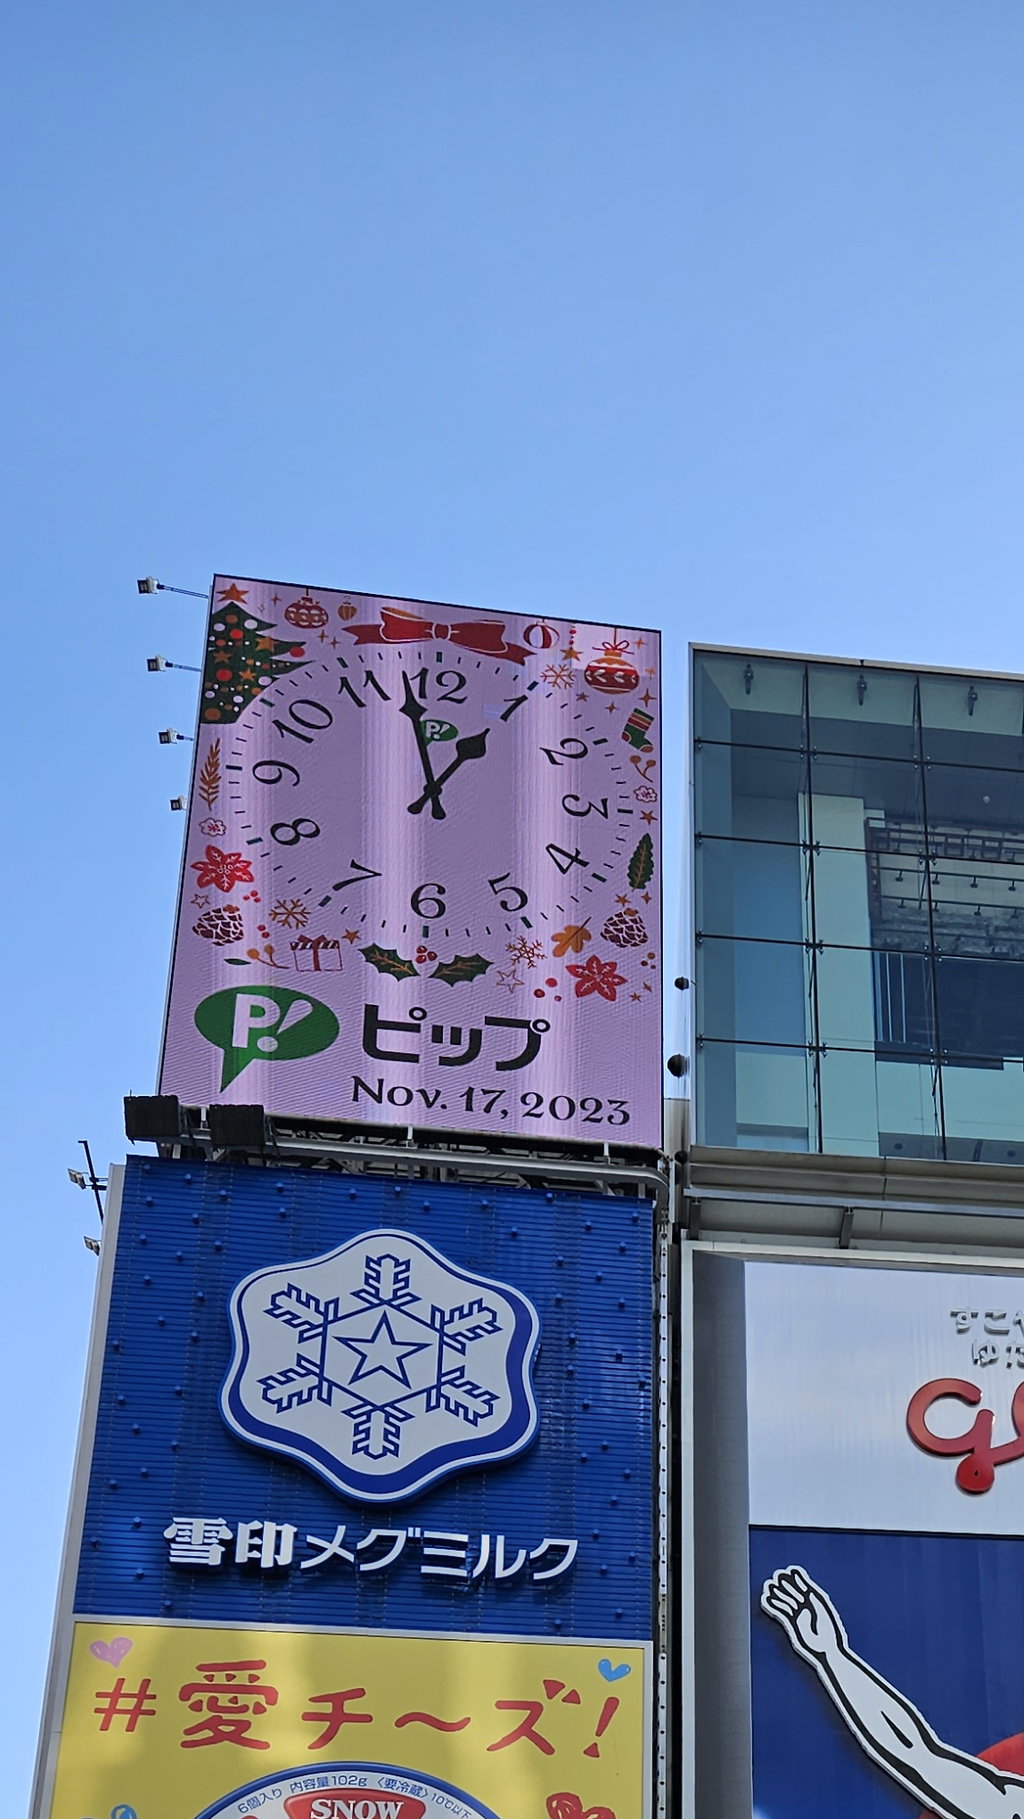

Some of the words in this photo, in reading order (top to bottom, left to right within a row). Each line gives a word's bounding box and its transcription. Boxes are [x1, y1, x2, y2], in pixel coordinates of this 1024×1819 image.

[338, 672, 392, 708] 11
[410, 667, 468, 704] 12
[274, 699, 333, 744] 10
[501, 695, 528, 722] 1
[539, 737, 588, 766] 2
[252, 759, 300, 787] 9
[562, 793, 609, 820] 3
[270, 817, 320, 846] 8
[332, 858, 382, 892] 7
[545, 841, 589, 875] 4
[411, 883, 446, 919] 6
[488, 872, 528, 913] 5
[362, 1003, 550, 1071] ピップ
[163, 1517, 578, 1580] 雪印メグミルク
